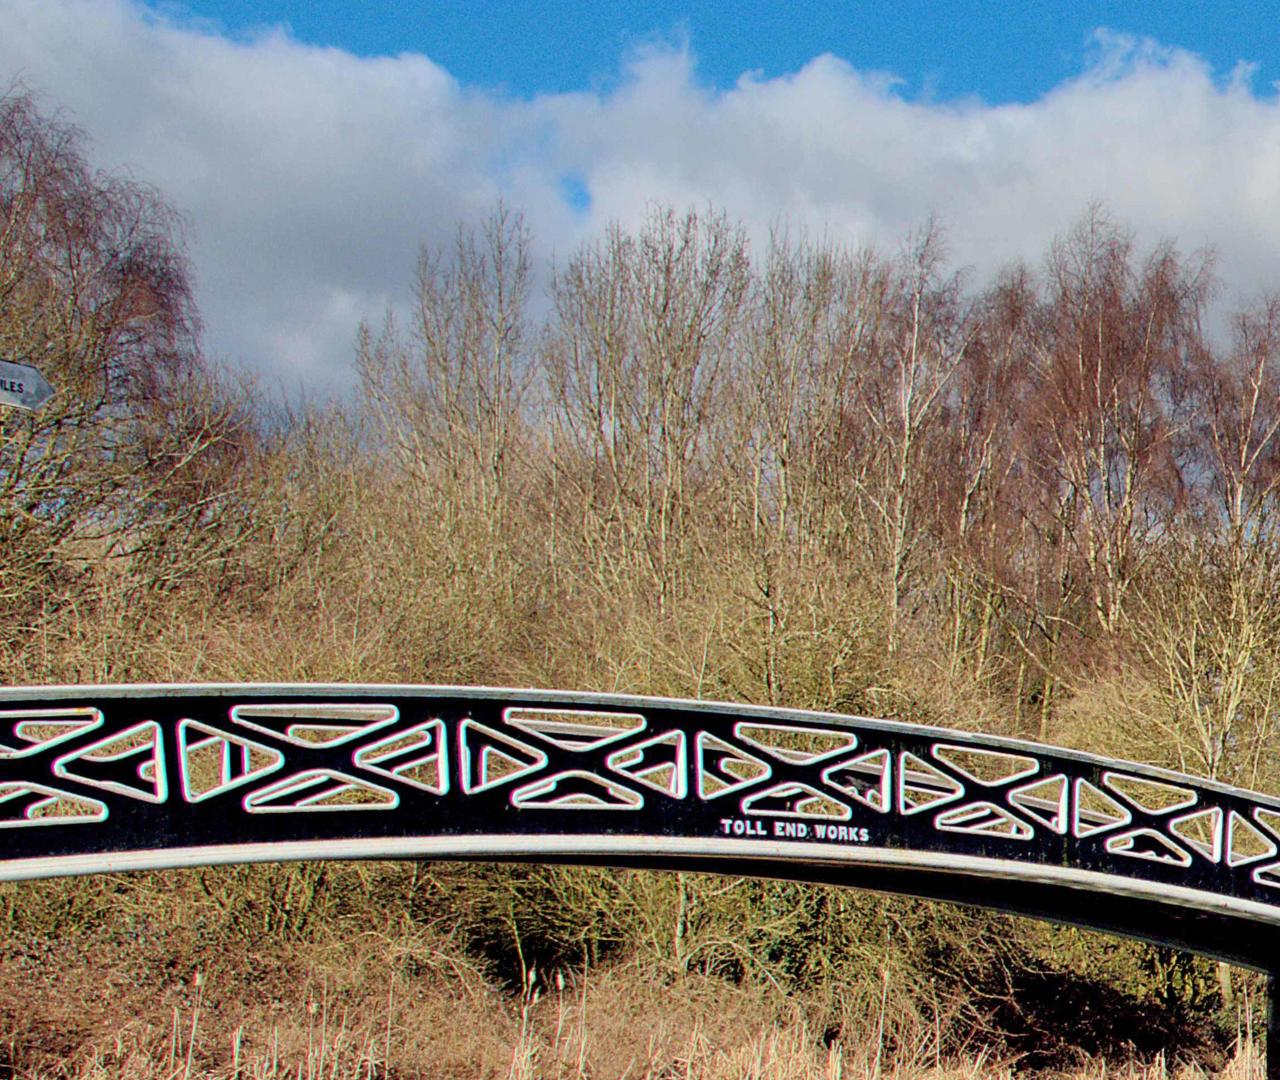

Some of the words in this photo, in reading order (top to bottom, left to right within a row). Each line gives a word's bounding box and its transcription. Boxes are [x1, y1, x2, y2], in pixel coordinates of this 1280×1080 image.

[0, 378, 25, 394] ILES
[719, 818, 768, 836] TOLL
[773, 821, 808, 838] END
[814, 824, 870, 842] WORKS
